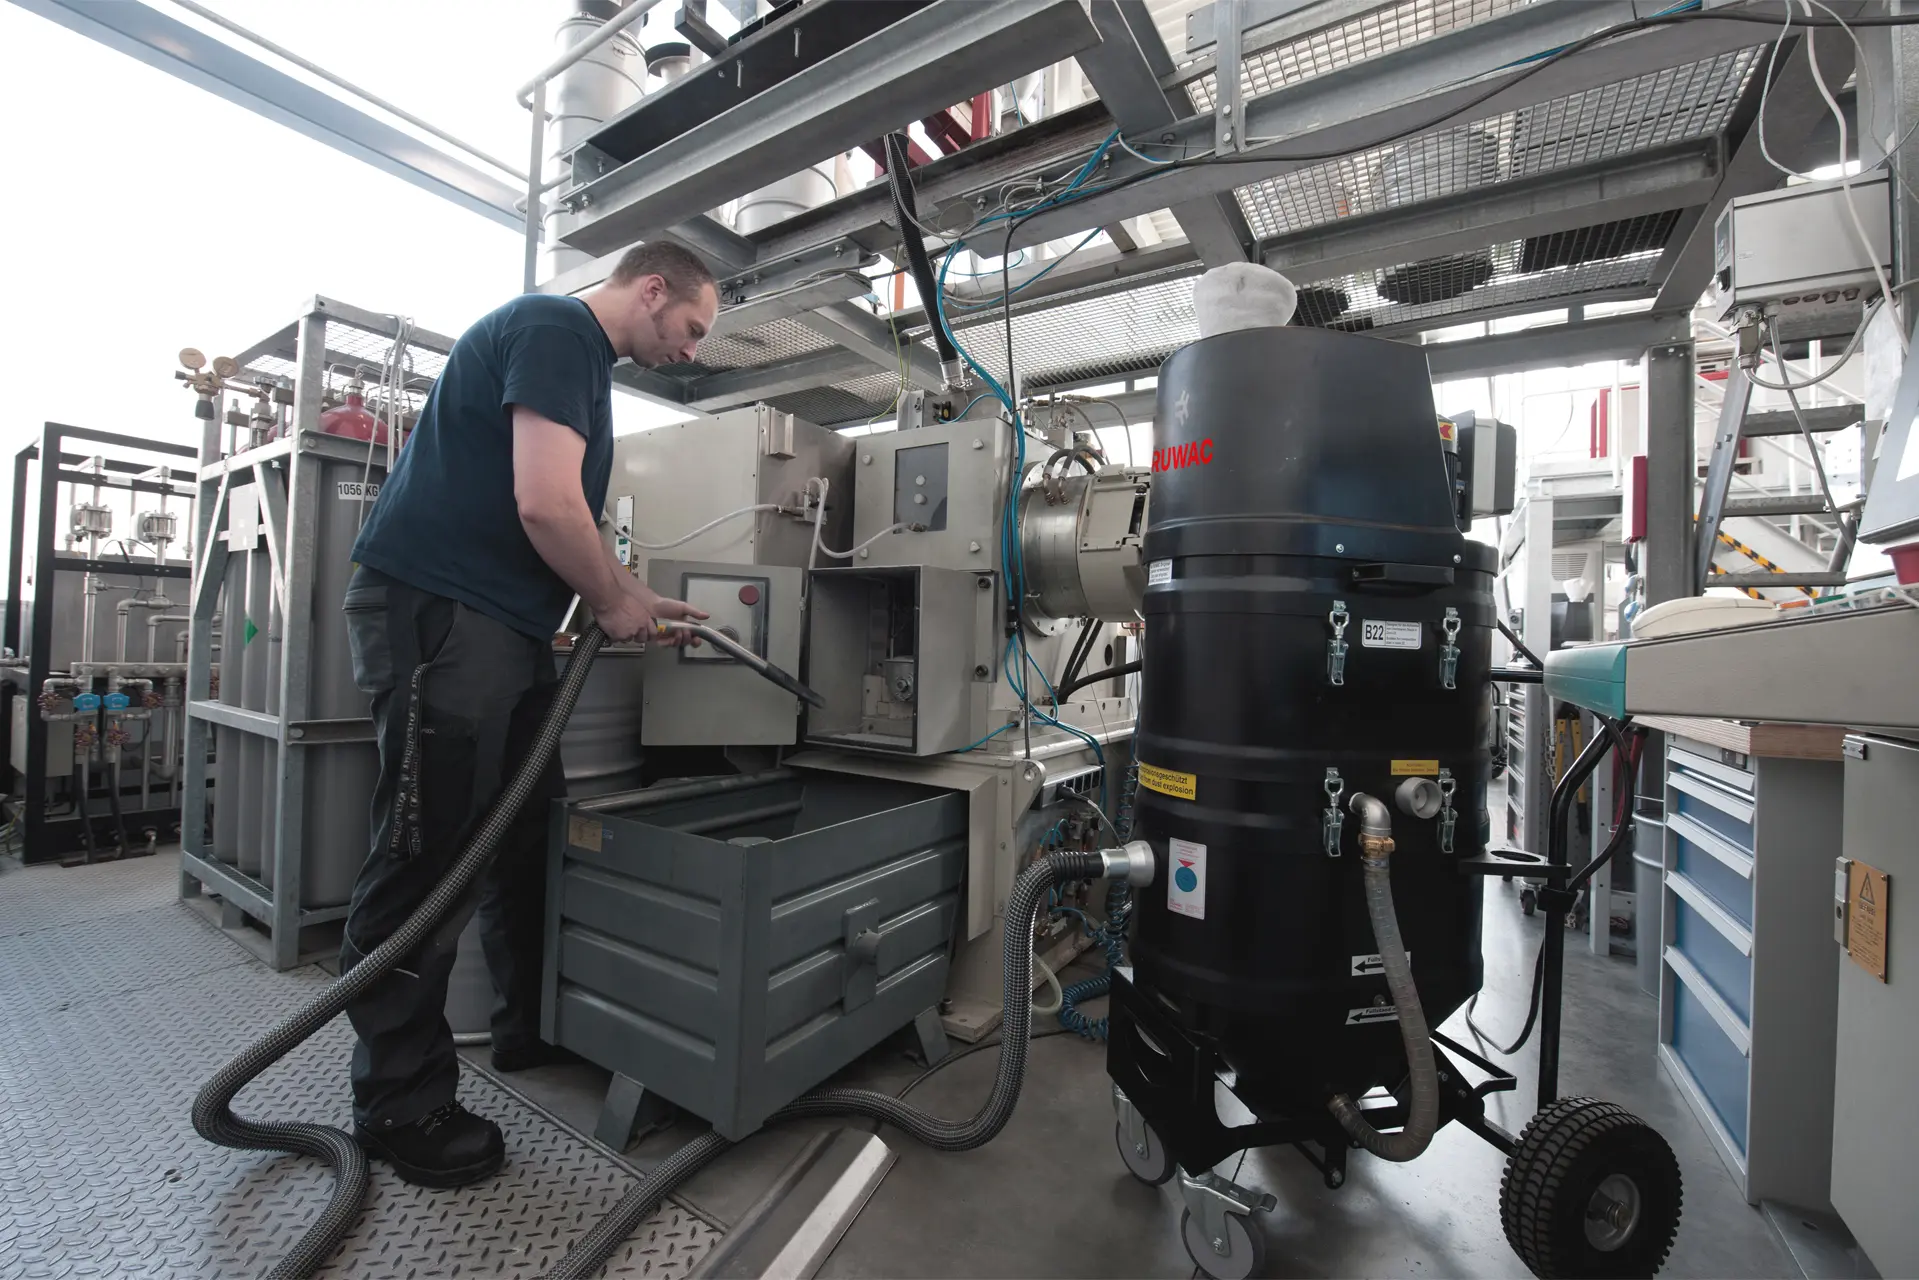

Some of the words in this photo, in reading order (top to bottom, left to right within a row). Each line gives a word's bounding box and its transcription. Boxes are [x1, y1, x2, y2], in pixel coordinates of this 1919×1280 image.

[1152, 438, 1214, 473] RUWAC
[337, 484, 362, 496] 1056
[366, 485, 378, 497] KG
[1365, 624, 1384, 640] B22
[1163, 782, 1194, 795] explosion
